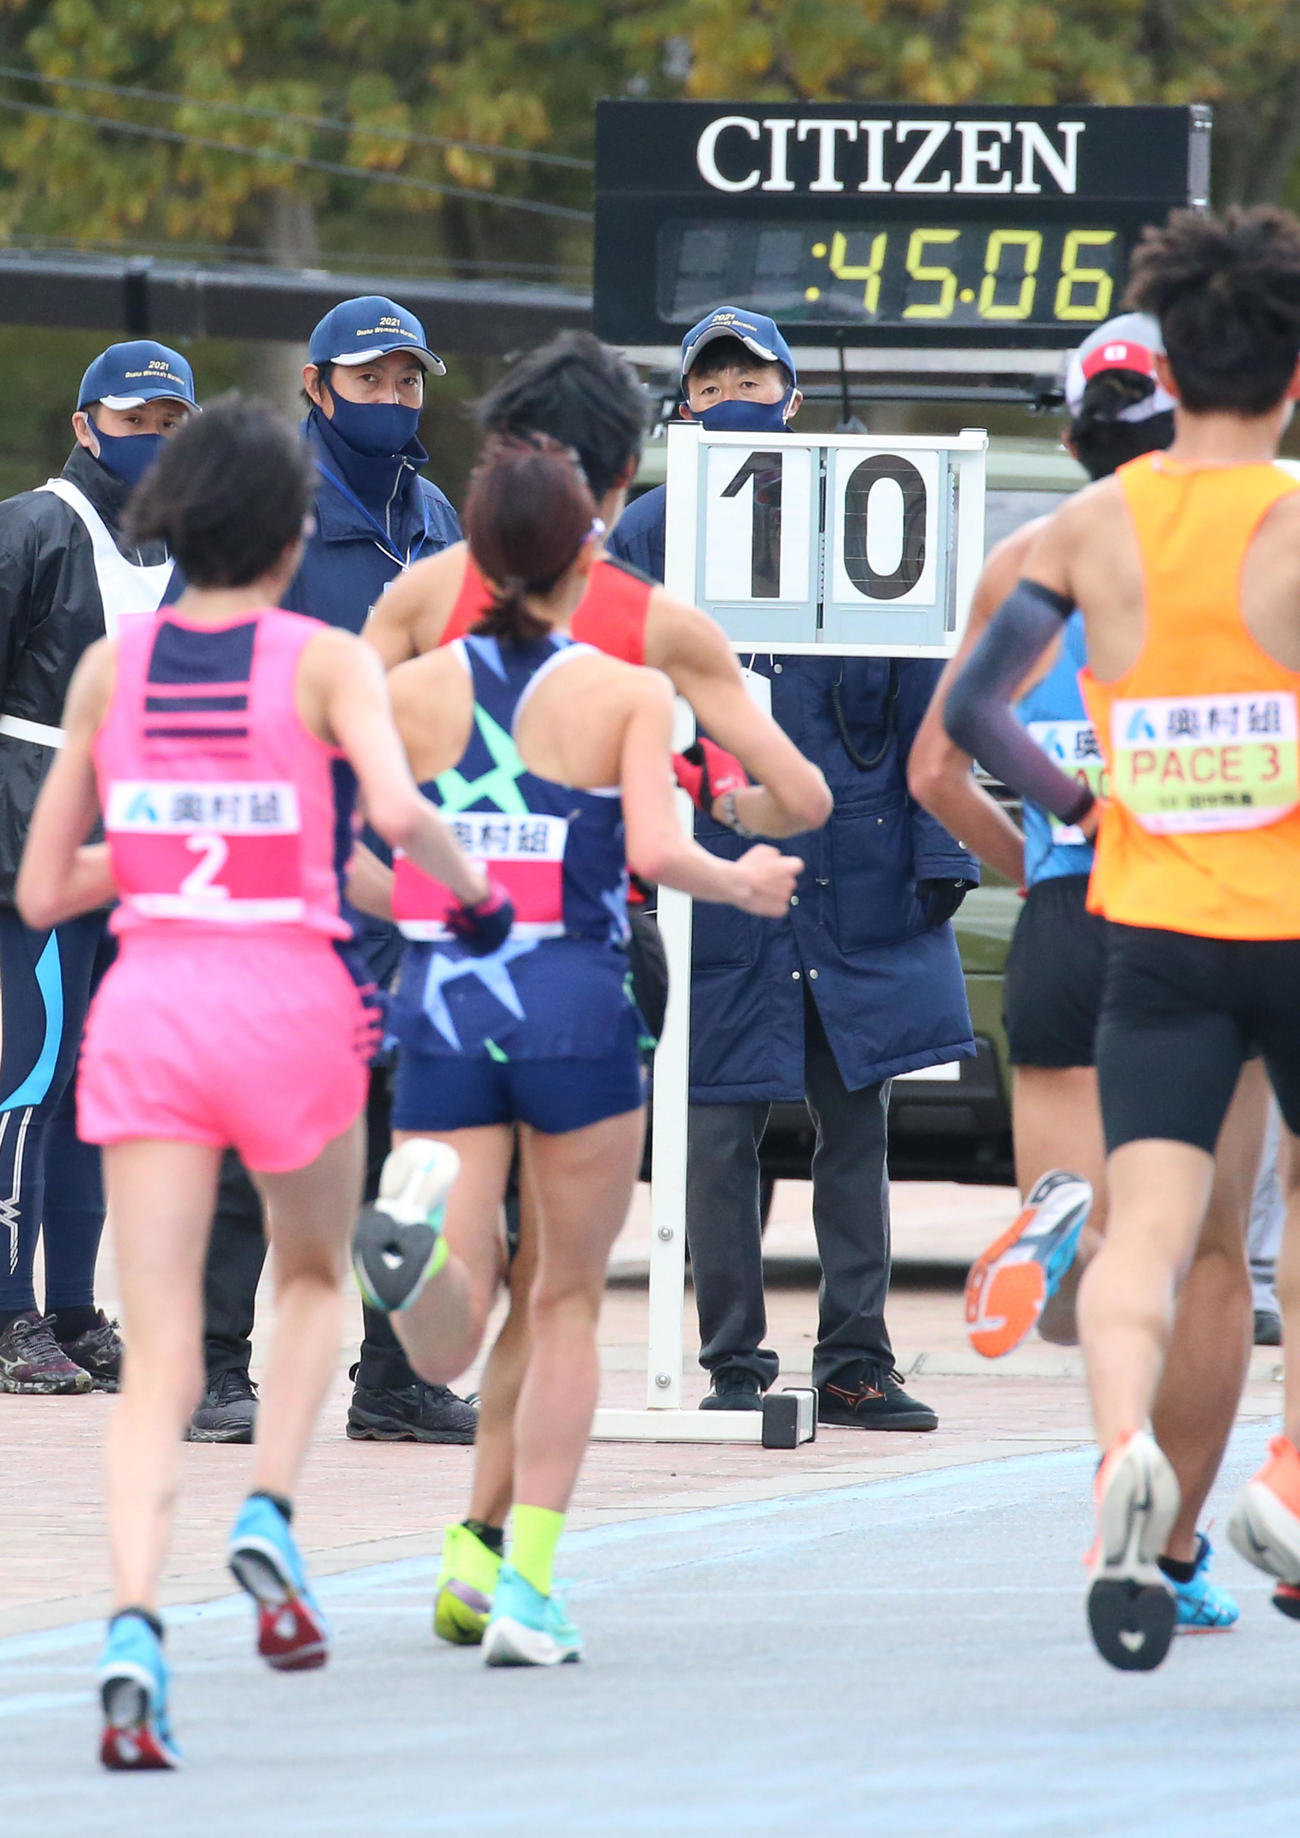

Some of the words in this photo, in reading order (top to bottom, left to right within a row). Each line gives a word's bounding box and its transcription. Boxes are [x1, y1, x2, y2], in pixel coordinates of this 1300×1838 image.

[697, 116, 1086, 194] CITIZEN
[379, 317, 400, 326] 2021
[712, 314, 735, 322] 2021
[148, 360, 169, 371] 2021
[720, 451, 927, 600] 10
[1131, 746, 1243, 785] PACE
[1259, 744, 1281, 783] 3
[179, 832, 231, 898] 2
